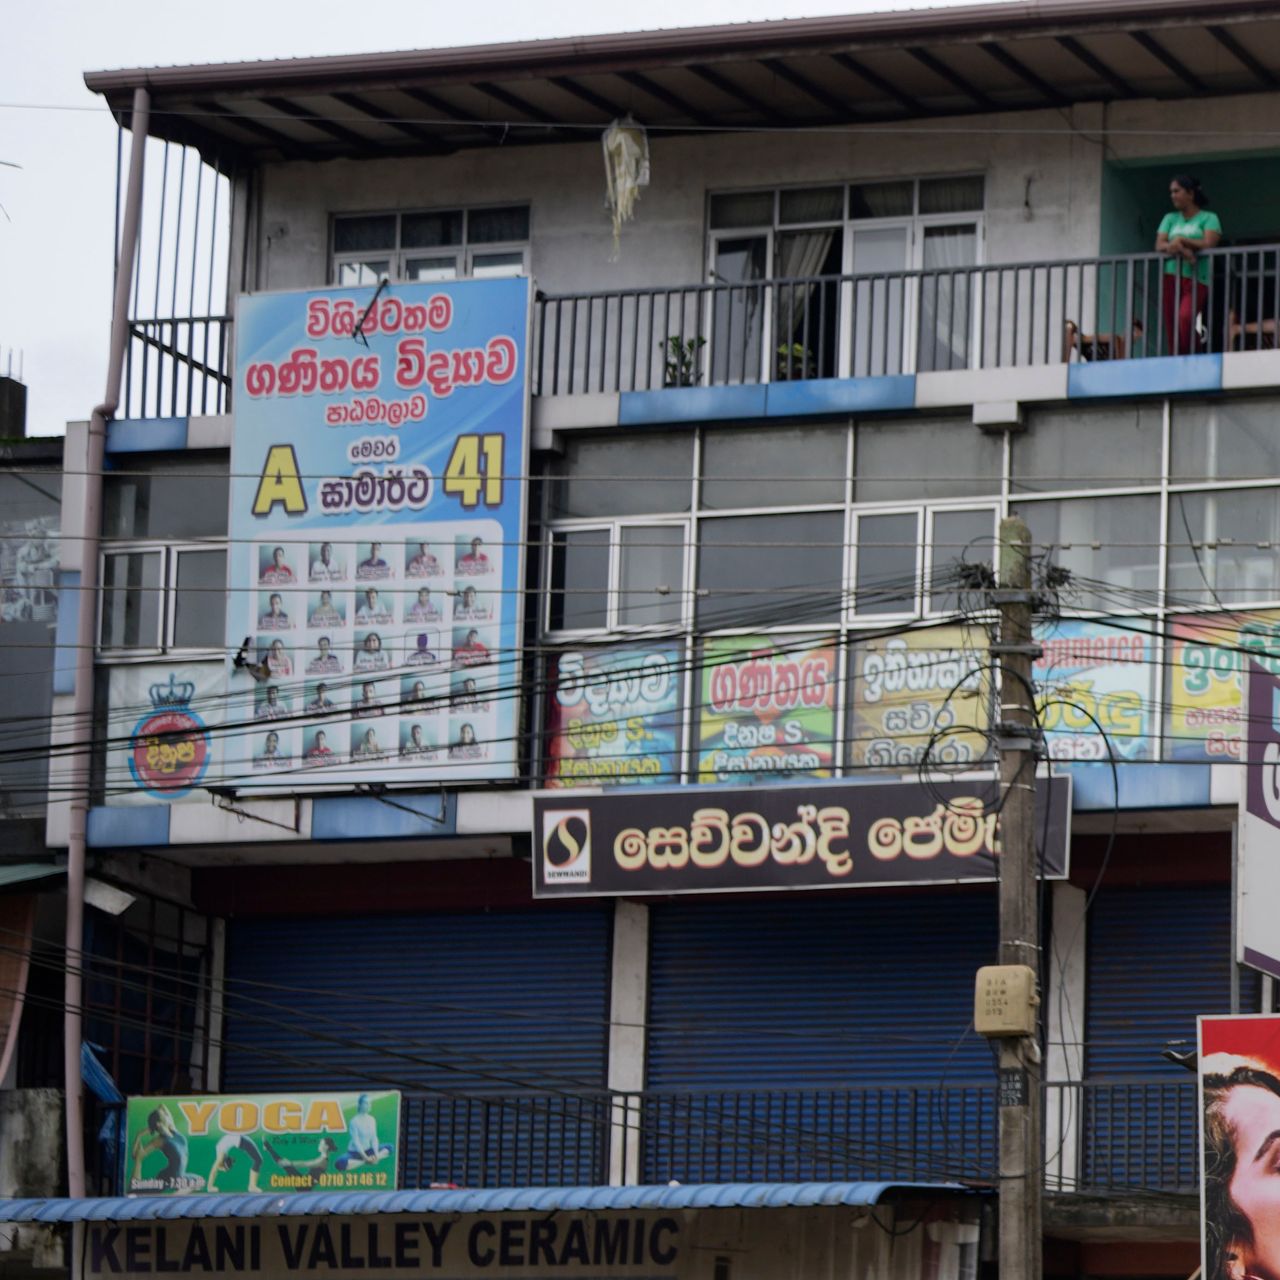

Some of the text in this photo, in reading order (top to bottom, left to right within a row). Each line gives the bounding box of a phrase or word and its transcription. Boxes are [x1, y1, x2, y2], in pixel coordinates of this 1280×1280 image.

[246, 336, 516, 396] ගණිතය විද්‍යාව
[252, 444, 308, 516] A
[442, 432, 504, 507] 41
[177, 1099, 348, 1136] YOGA
[271, 1174, 313, 1188] Contact
[91, 1217, 680, 1273] KELANI VALLEY CERAMIC
